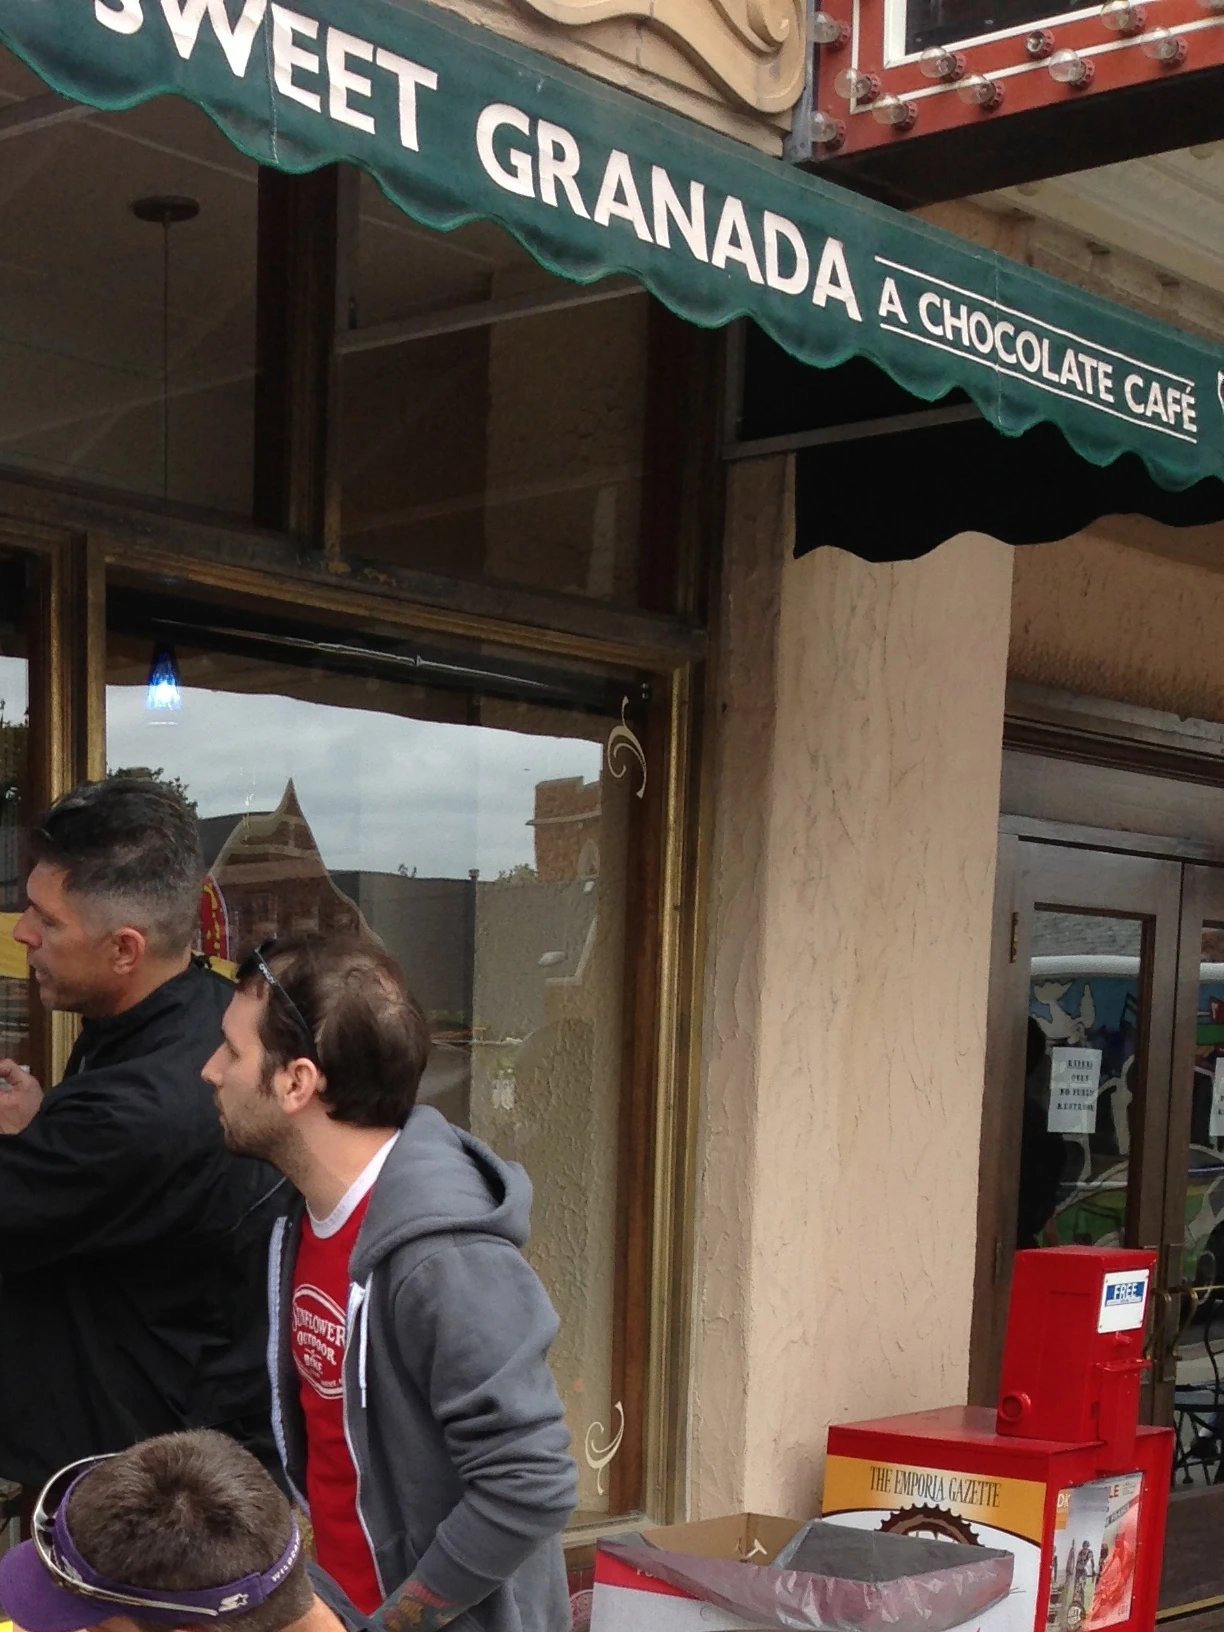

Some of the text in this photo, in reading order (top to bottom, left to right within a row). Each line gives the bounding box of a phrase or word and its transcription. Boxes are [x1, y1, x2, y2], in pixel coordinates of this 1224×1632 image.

[476, 102, 863, 323] GRANADA
[878, 277, 1197, 433] A CHOCOLATE CAFÉ
[1114, 1283, 1138, 1300] FREE
[869, 1466, 1002, 1508] THE EMPORIA GAZETTE
